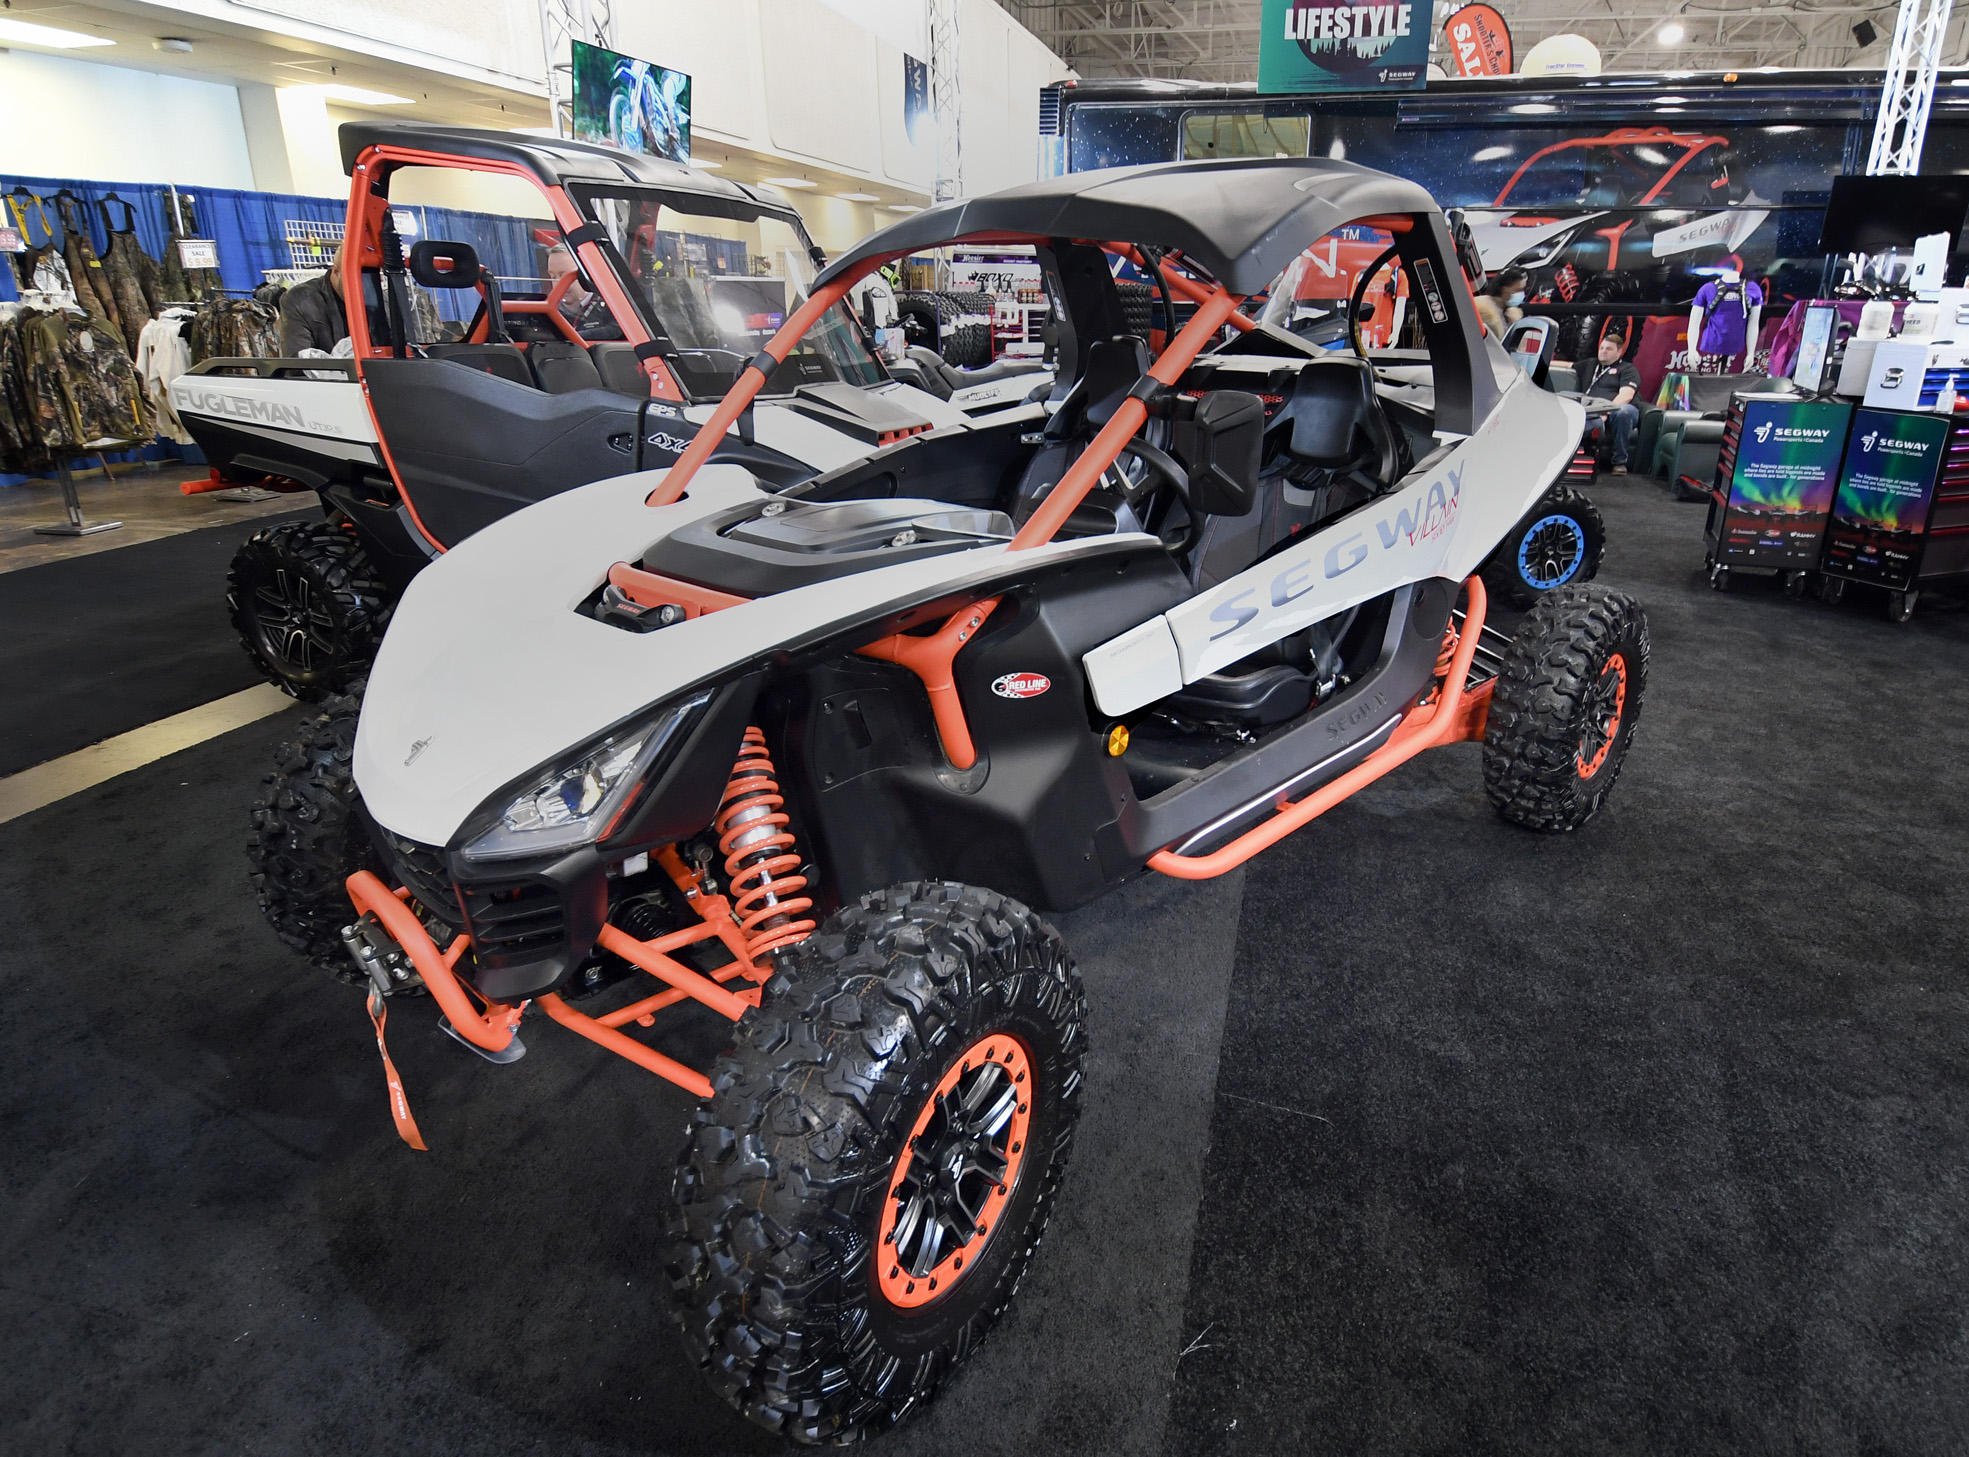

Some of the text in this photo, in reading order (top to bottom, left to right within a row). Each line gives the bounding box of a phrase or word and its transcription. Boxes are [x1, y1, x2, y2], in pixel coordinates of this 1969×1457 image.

[1284, 4, 1412, 40] LIFESTYLE
[1453, 22, 1486, 77] SAL
[1342, 229, 1360, 240] TM
[1679, 218, 1730, 243] SEGWA
[1664, 350, 1736, 370] Hosir
[173, 386, 306, 428] FUGLEMAN
[648, 403, 677, 418] EPS
[1774, 428, 1830, 438] SEGWAY
[1879, 438, 1930, 452] SEGWAY
[1409, 489, 1460, 546] VILLAIN
[1209, 459, 1464, 642] SEGWAY
[616, 603, 640, 614] SEGWAY
[1009, 680, 1026, 690] RED
[1027, 679, 1047, 688] LINE
[1327, 692, 1387, 741] SEGWAY
